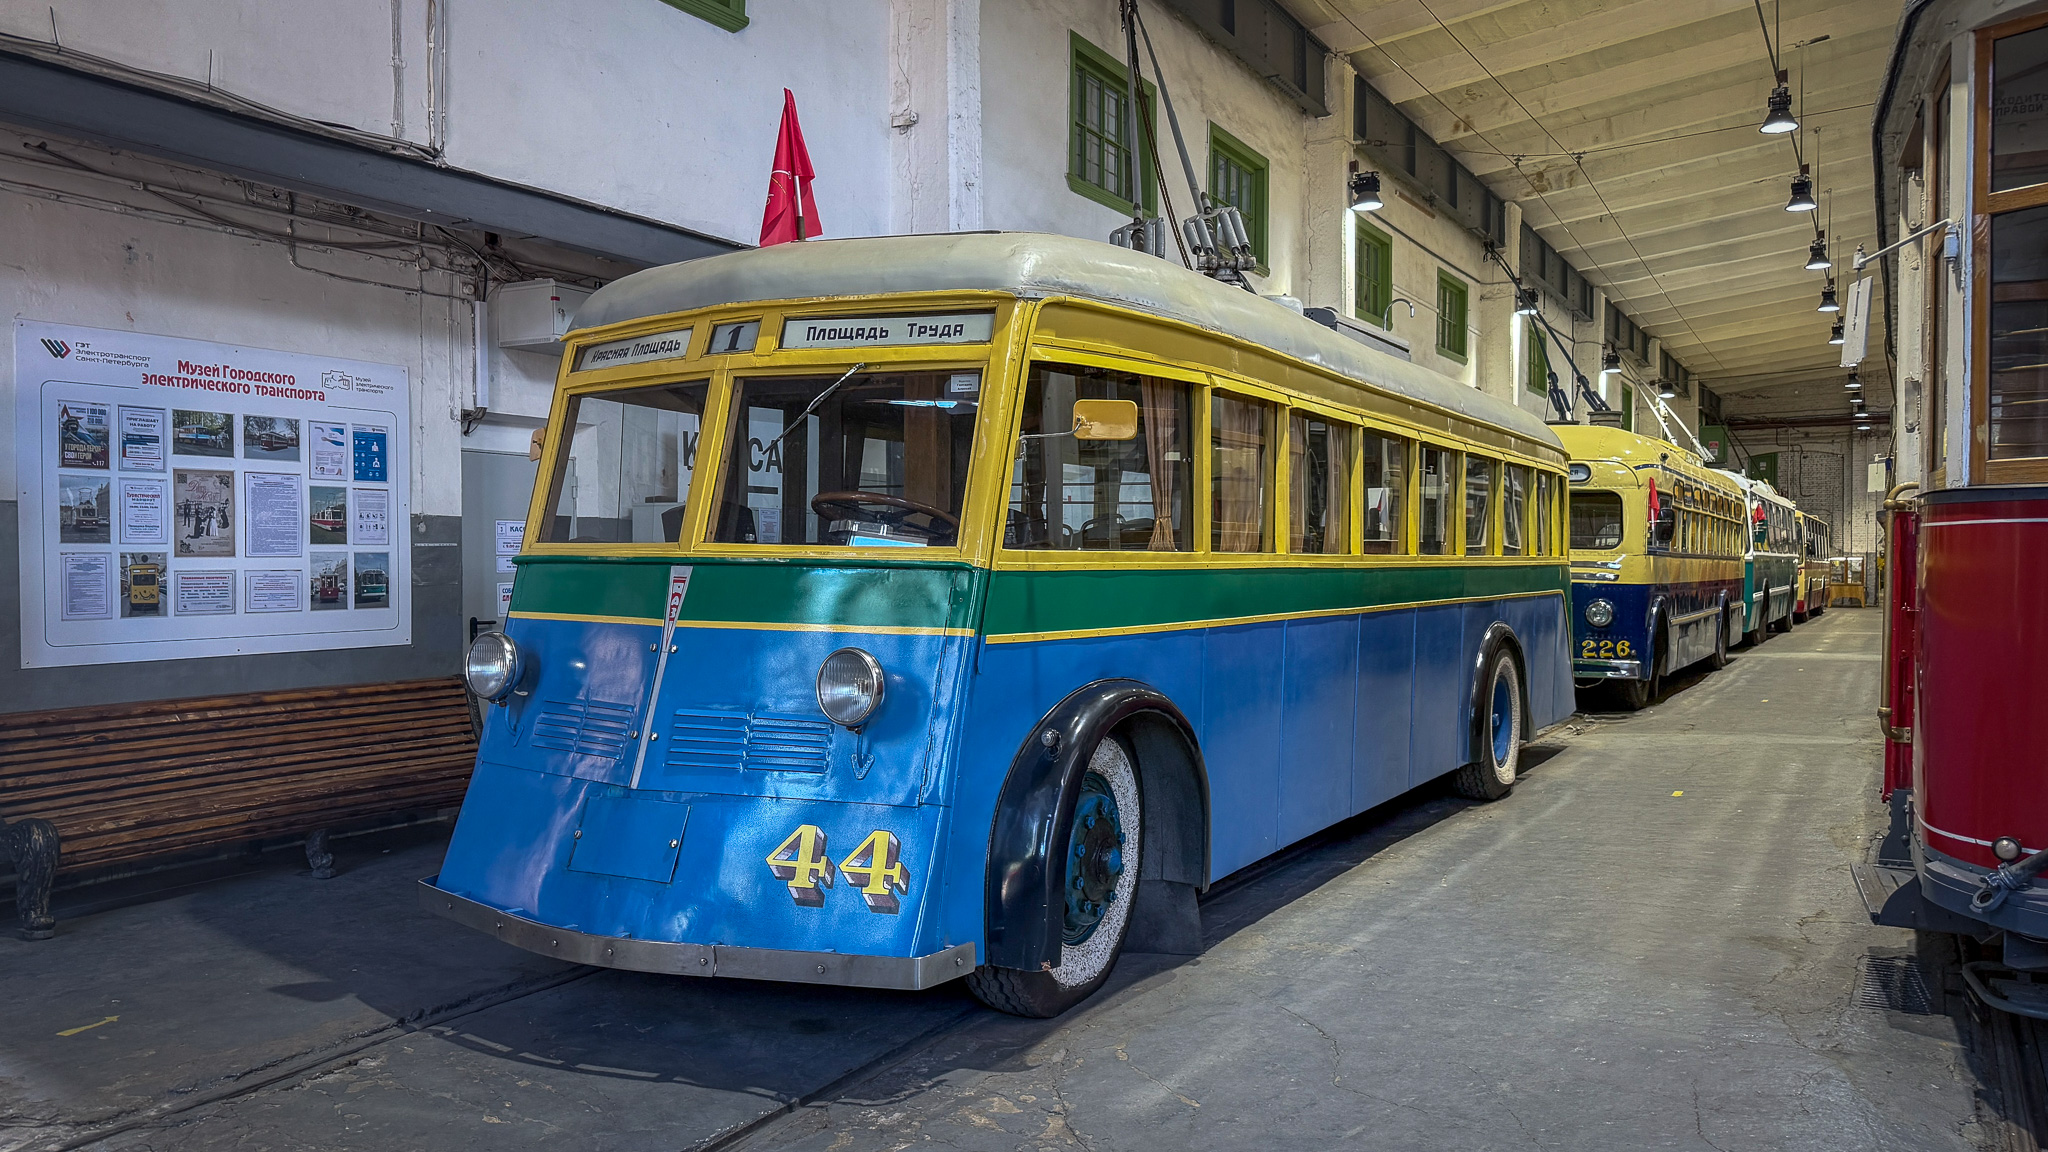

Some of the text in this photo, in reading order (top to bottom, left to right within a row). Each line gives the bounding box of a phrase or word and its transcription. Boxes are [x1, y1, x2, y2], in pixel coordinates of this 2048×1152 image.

[1996, 93, 2048, 106] ХОДИТЬ
[1996, 101, 2043, 117] ПРАВОЙ
[723, 325, 745, 351] 1
[75, 348, 151, 362] Электротранспорт
[75, 355, 150, 368] Санкт-Петербурга
[177, 360, 296, 386] Музей Городского
[142, 373, 326, 402] электрического транспорта
[1581, 640, 1631, 658] 226
[764, 823, 911, 915] 44
